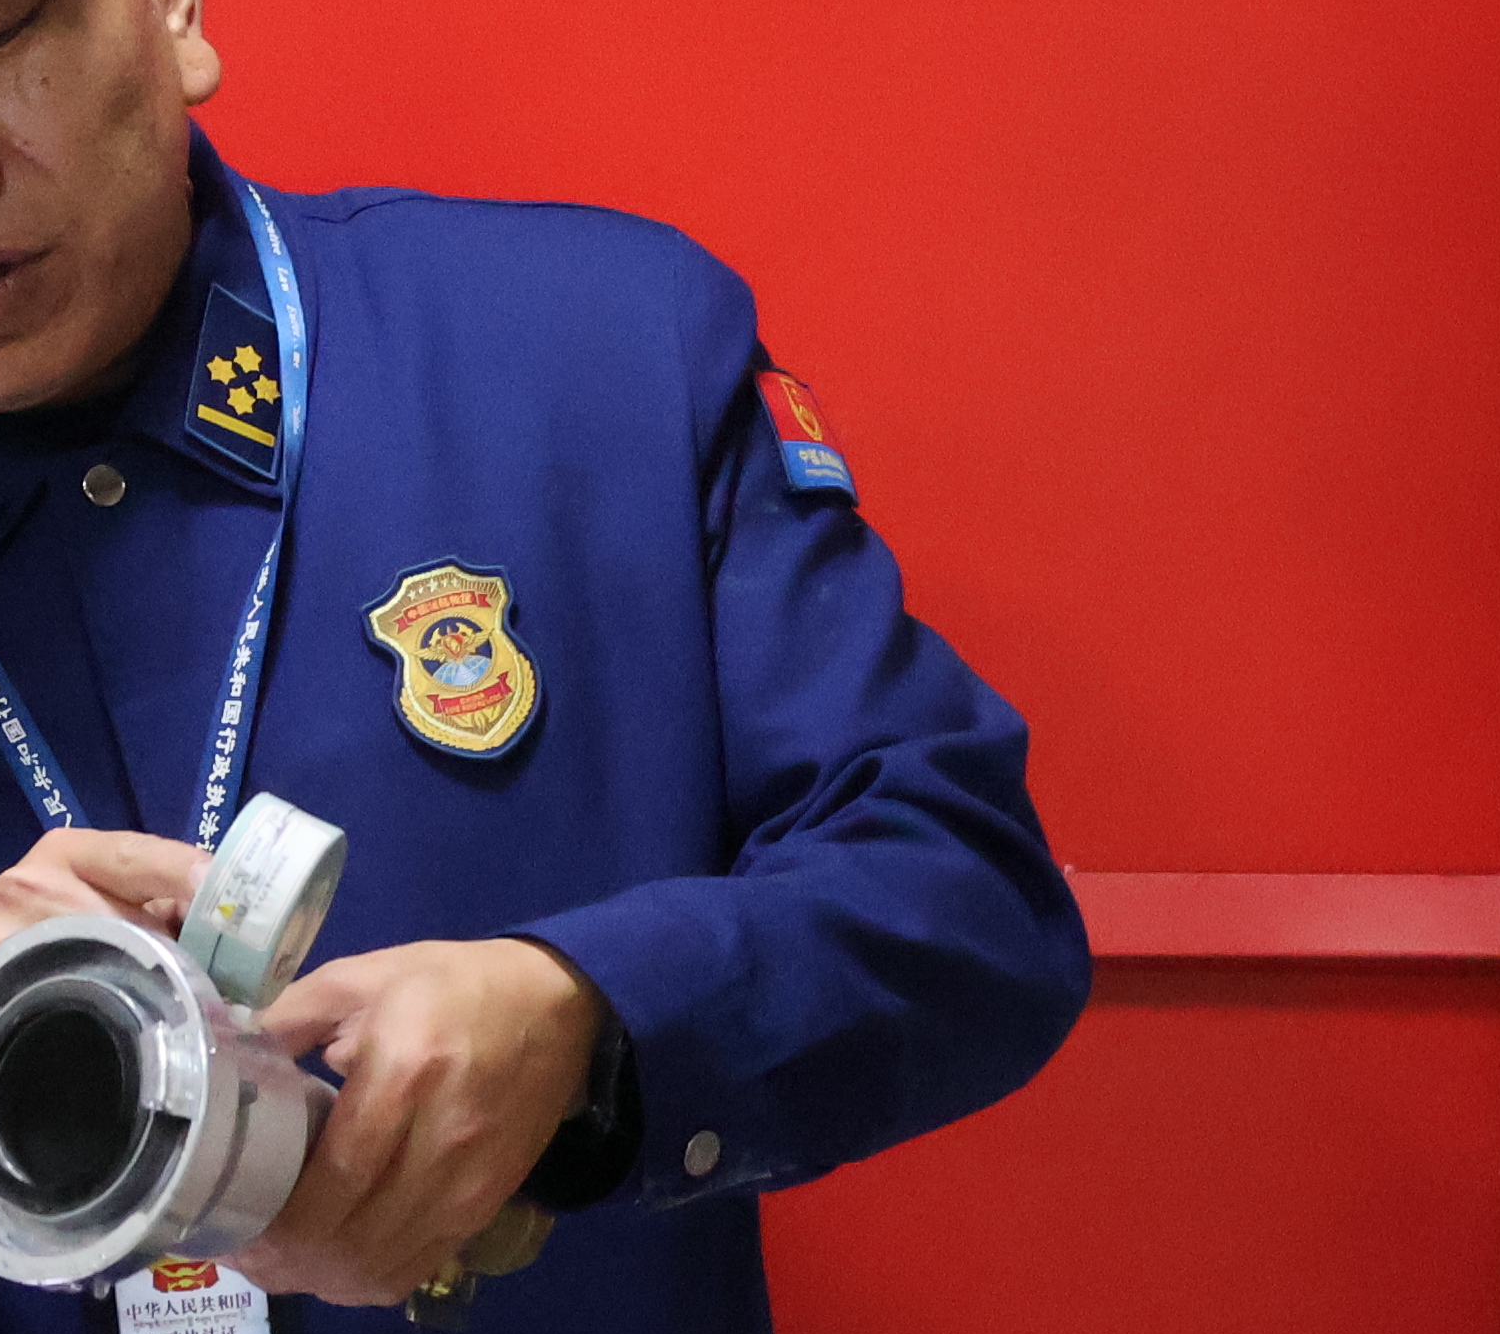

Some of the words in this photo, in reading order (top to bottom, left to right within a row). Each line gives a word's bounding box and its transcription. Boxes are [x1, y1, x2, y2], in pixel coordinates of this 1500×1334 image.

[126, 1292, 251, 1320] 中华人民共和国
